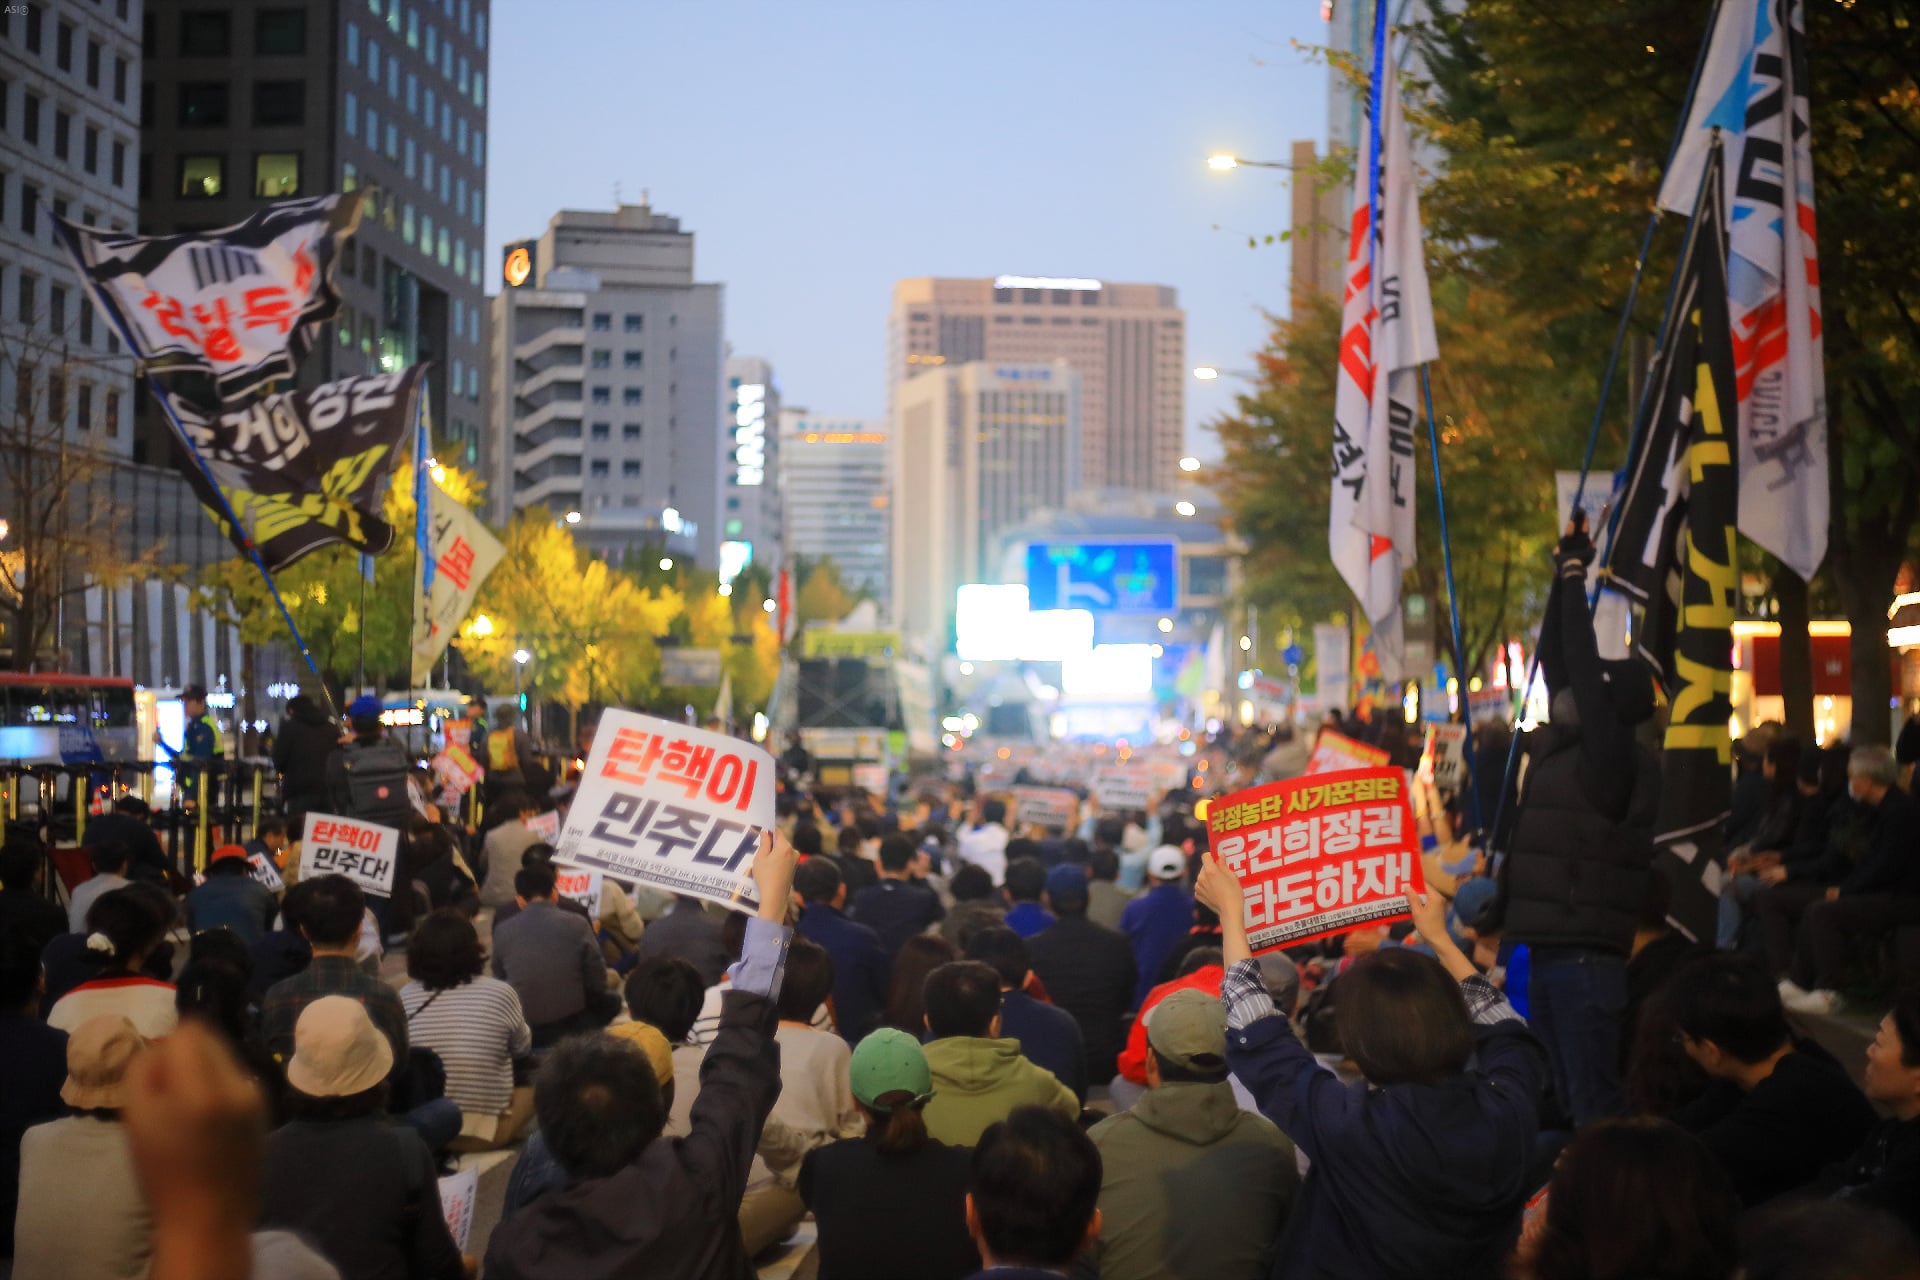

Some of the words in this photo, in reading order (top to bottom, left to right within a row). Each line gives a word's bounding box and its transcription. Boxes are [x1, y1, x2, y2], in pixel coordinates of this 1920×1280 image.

[600, 727, 758, 812] 탄핵이
[310, 820, 382, 853] 탄핵이
[1211, 796, 1283, 834] 국정농단
[1287, 777, 1402, 814] 사기꾼집단
[1243, 851, 1412, 930] 타도하자!
